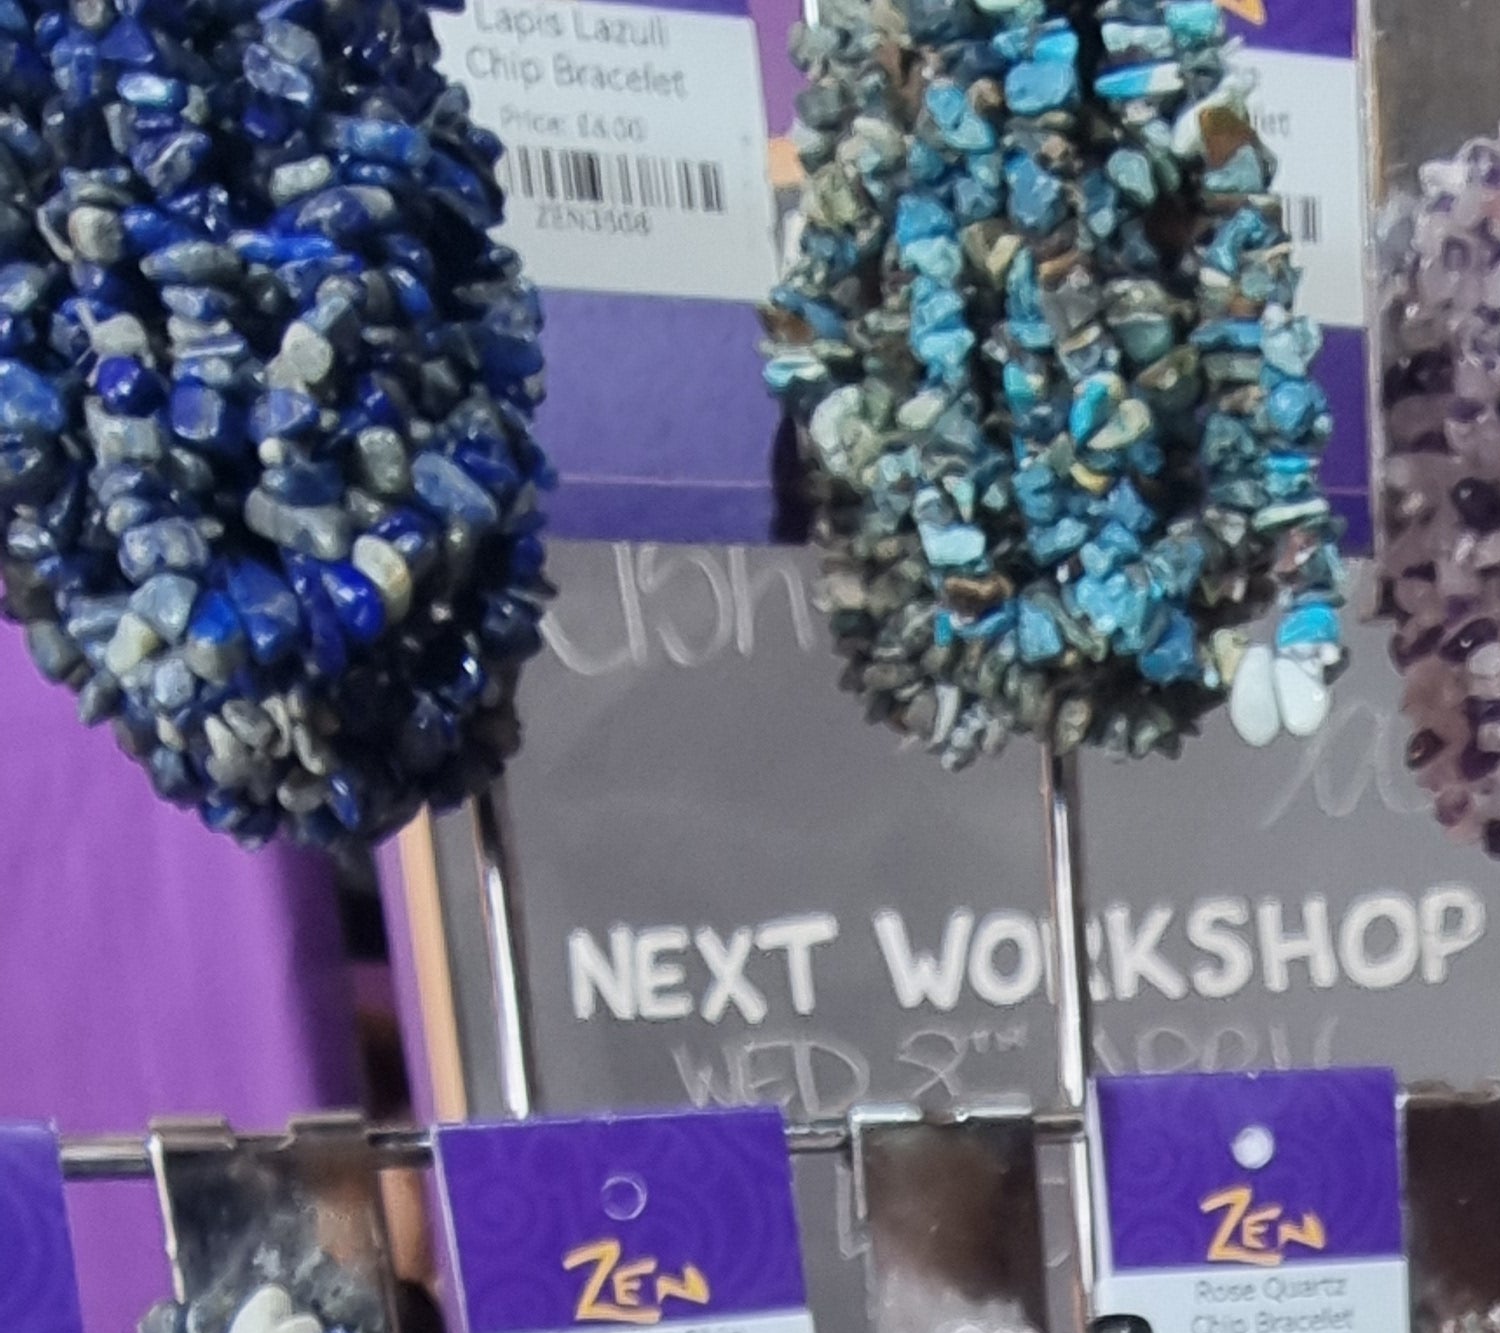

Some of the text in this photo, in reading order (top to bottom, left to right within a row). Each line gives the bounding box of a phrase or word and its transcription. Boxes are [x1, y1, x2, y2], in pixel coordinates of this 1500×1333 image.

[464, 45, 688, 100] Chip Bracelet
[566, 913, 840, 1025] NEXT
[1198, 1185, 1327, 1266] ZEN
[561, 1238, 712, 1325] ZEN
[1194, 1275, 1347, 1304] Rose Quartz
